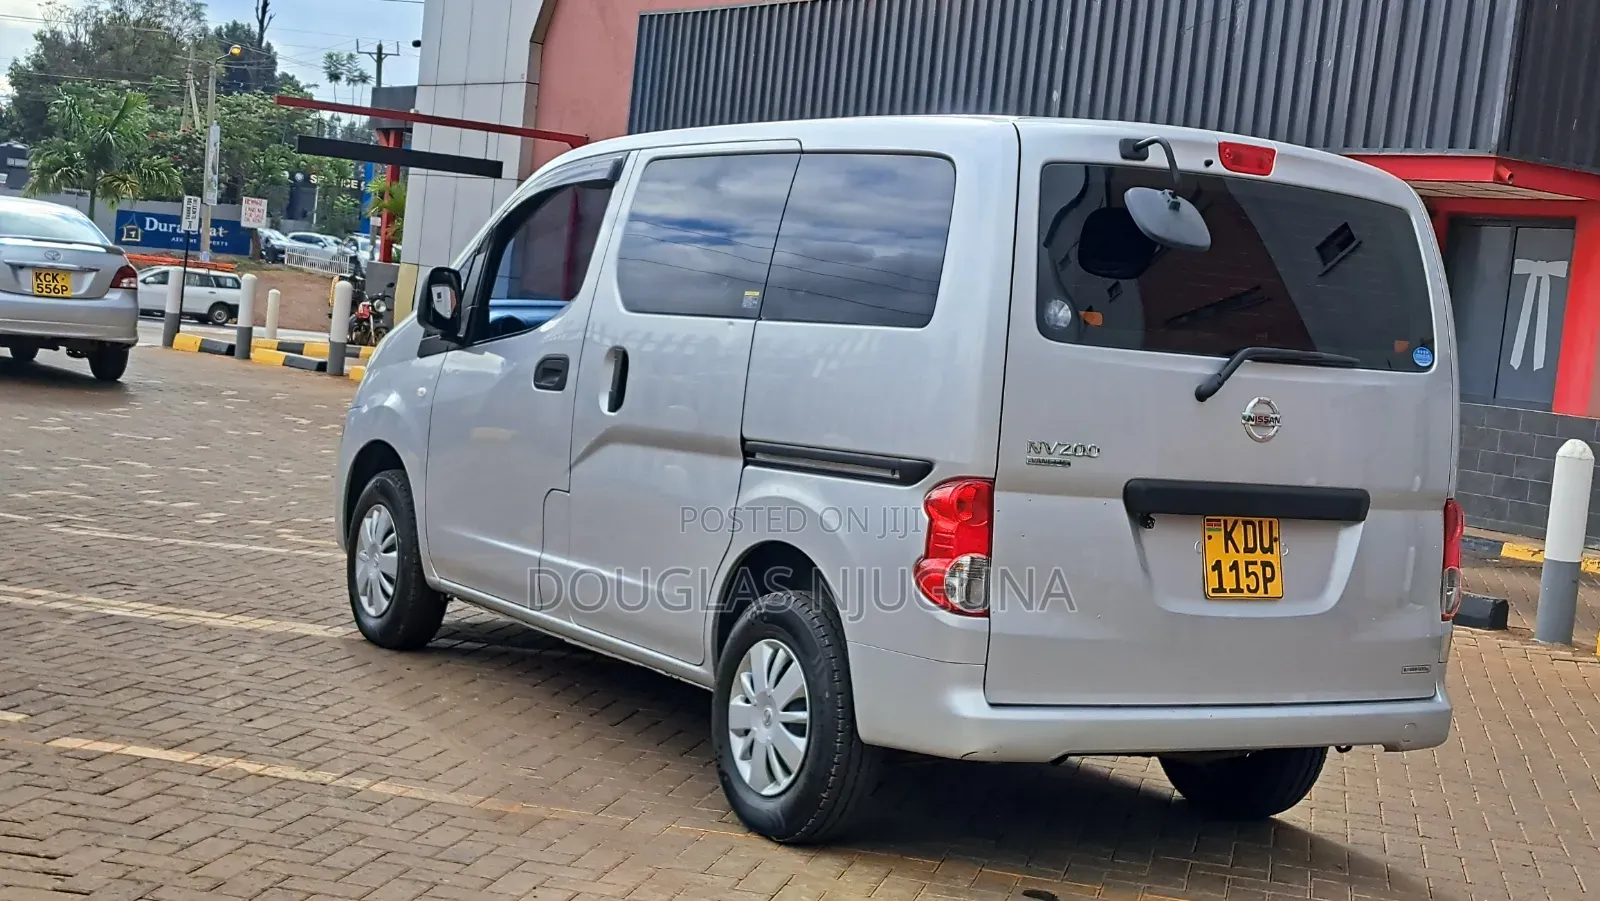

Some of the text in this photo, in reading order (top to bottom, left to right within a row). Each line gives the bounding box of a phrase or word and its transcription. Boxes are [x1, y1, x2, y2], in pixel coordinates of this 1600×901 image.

[309, 174, 358, 189] SEICE
[35, 272, 60, 284] KCK
[36, 283, 69, 295] 556P
[1246, 415, 1281, 424] NISSAN
[1026, 439, 1101, 458] NV200
[1222, 519, 1274, 555] KDU
[1211, 559, 1276, 595] 115P
